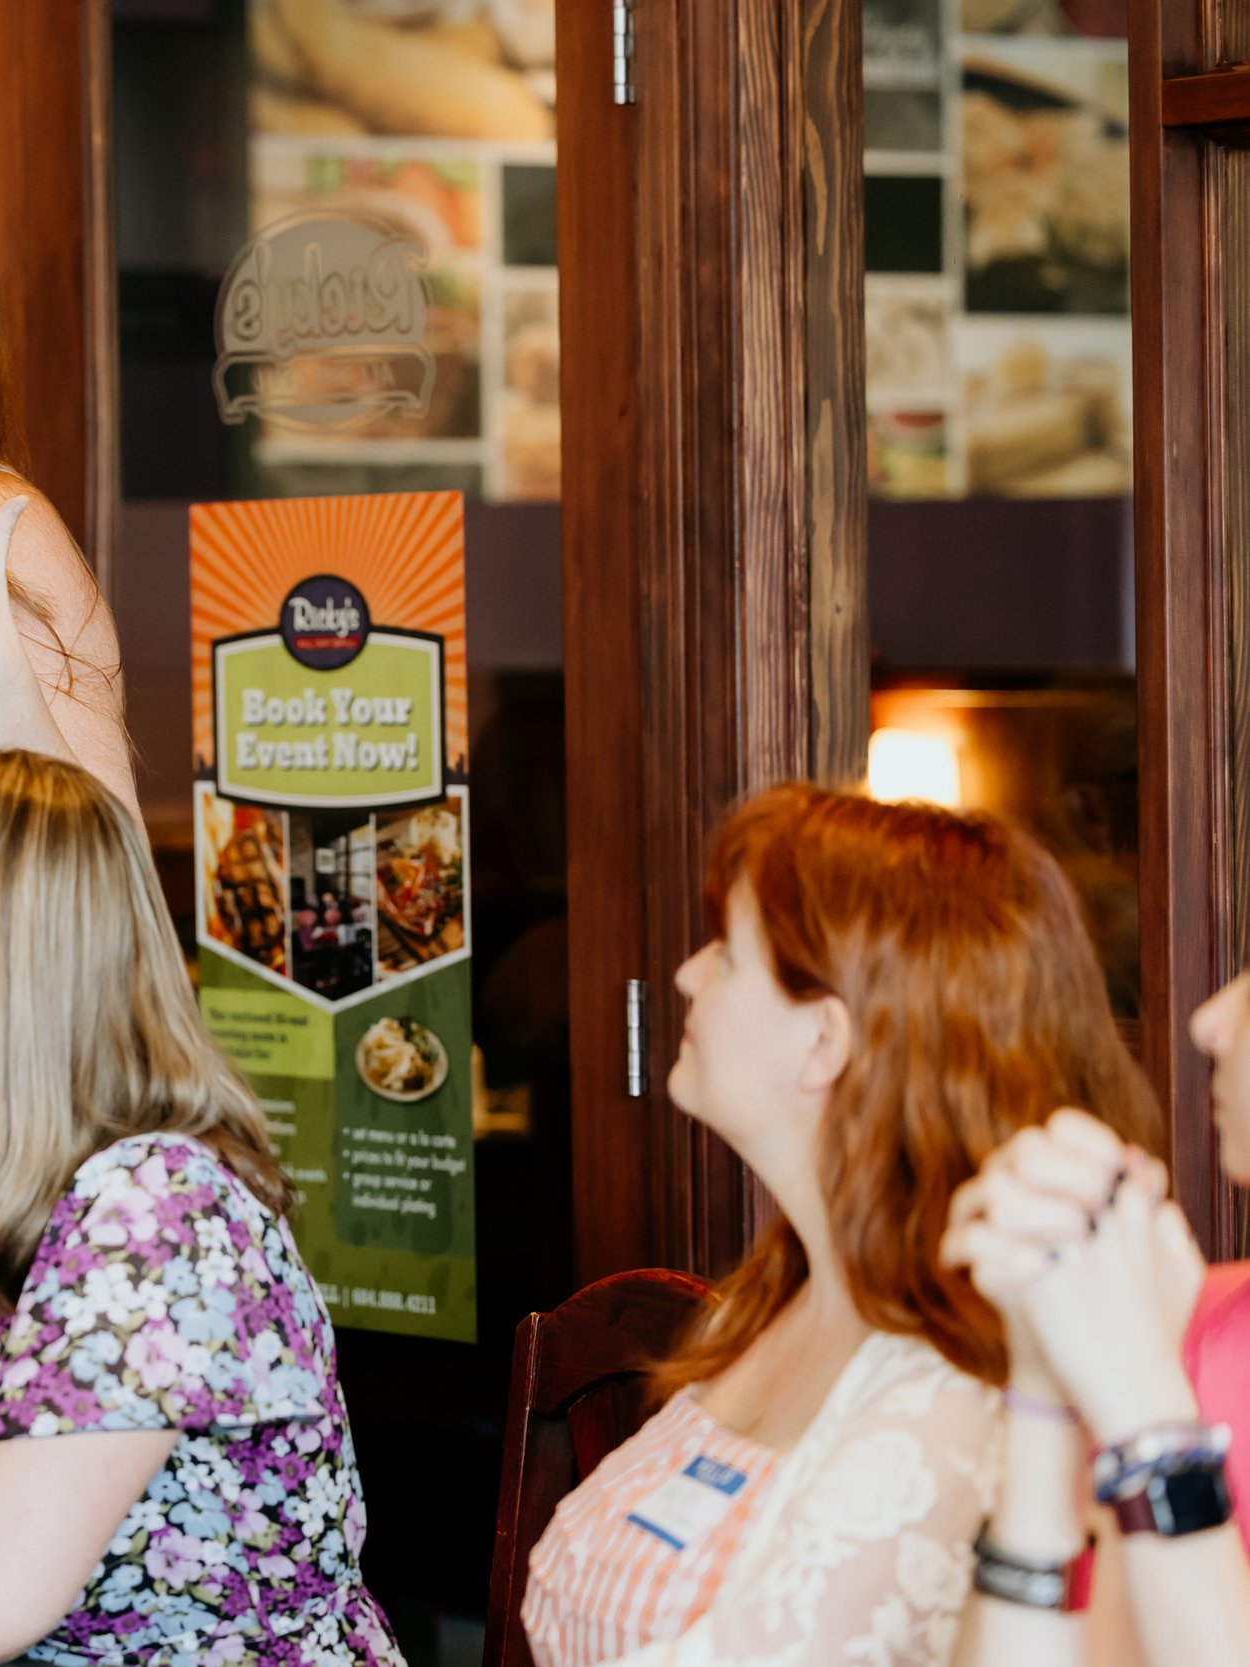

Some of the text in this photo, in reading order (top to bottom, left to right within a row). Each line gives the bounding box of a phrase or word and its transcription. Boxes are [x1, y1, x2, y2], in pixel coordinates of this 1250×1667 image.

[288, 596, 360, 639] Ricky's
[241, 688, 412, 726] Book Your
[236, 732, 419, 771] Event Now!
